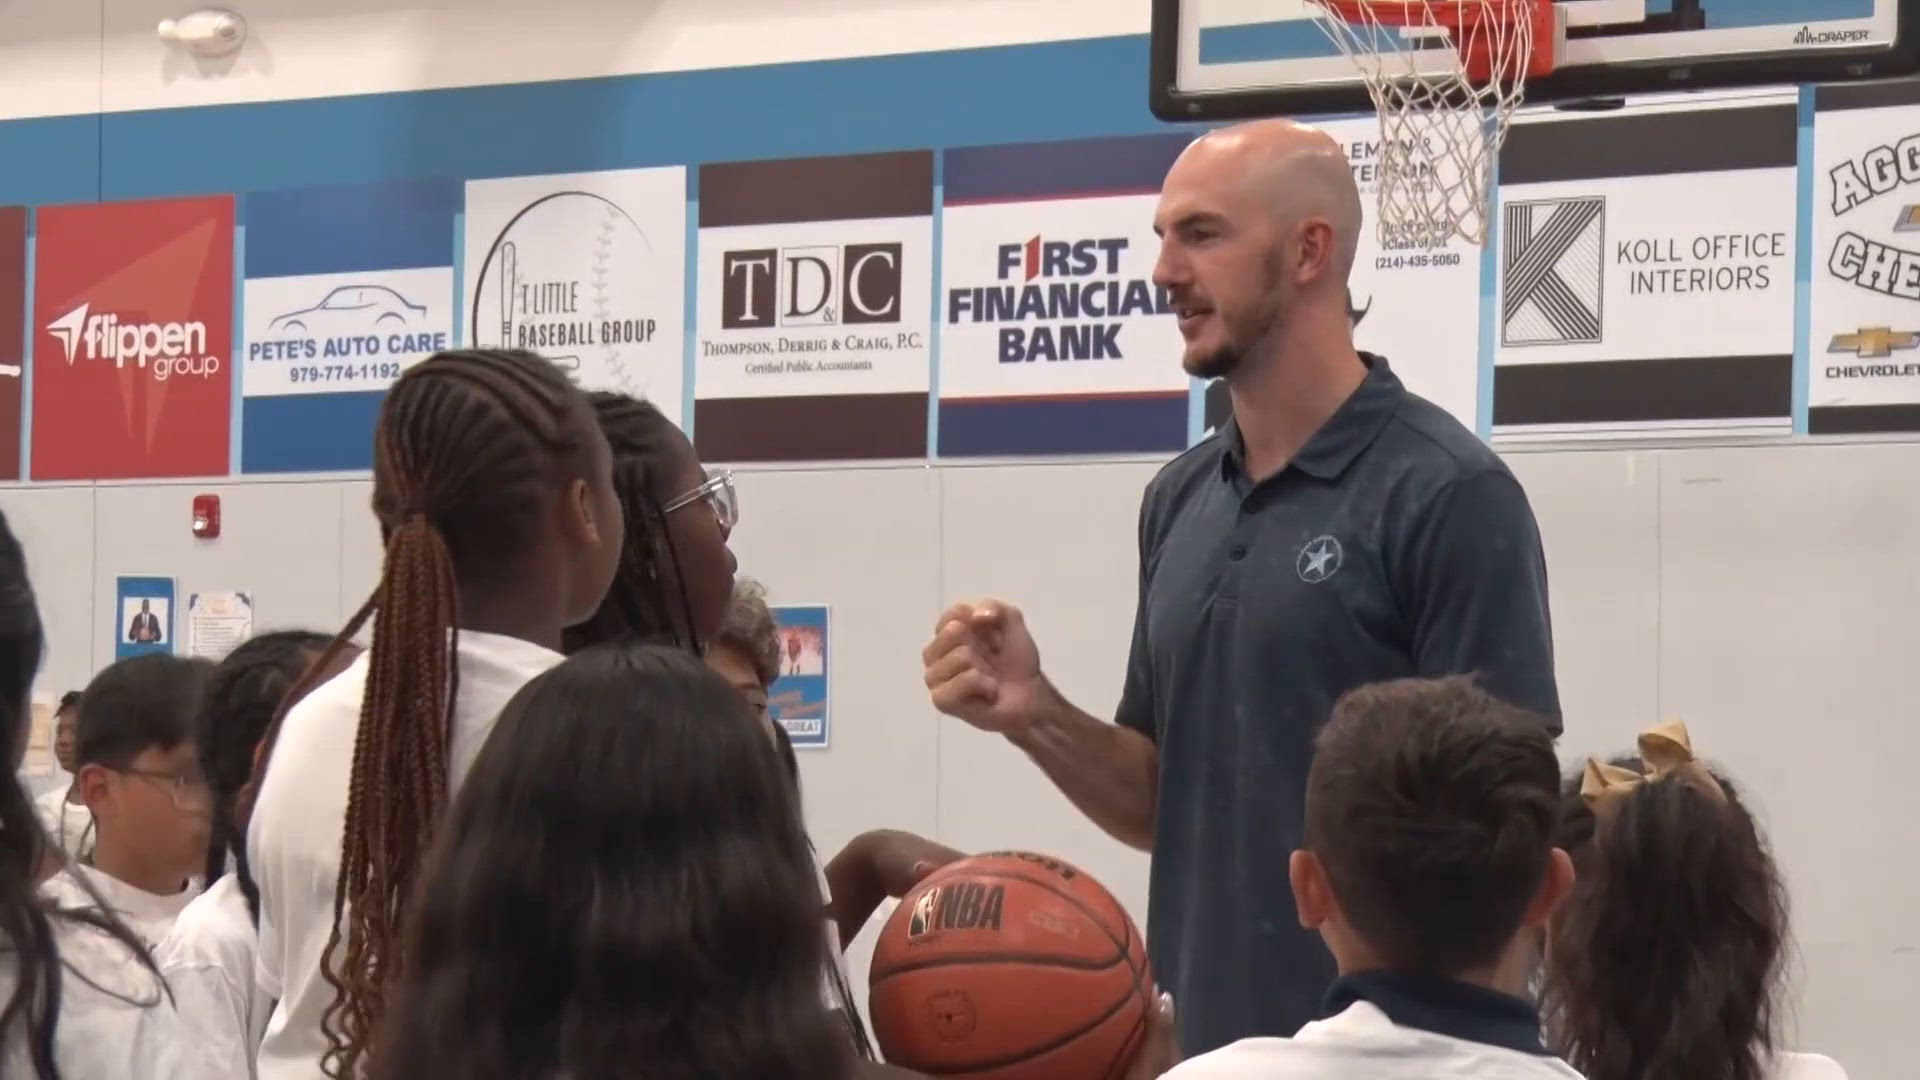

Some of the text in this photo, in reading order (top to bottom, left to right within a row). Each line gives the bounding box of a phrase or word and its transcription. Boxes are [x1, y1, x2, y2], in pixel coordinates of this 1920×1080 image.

[1818, 29, 1870, 42] DRAPER
[1617, 232, 1786, 264] KOLL OFFICE
[1630, 265, 1770, 294] INTERIORS
[521, 280, 579, 315] T LITTLE
[948, 279, 1177, 324] FINANCIAL
[84, 313, 206, 368] flippen
[249, 332, 447, 361] PETE'S AUTO CARE
[518, 318, 656, 348] BASEBALL GROUP
[831, 338, 840, 350] &
[897, 332, 923, 349] P.C.
[998, 322, 1124, 363] BANK
[153, 355, 220, 381] group
[290, 362, 401, 382] 979-774-1192
[745, 359, 873, 375] Certified Public Accountants
[935, 883, 1005, 930] NBA
